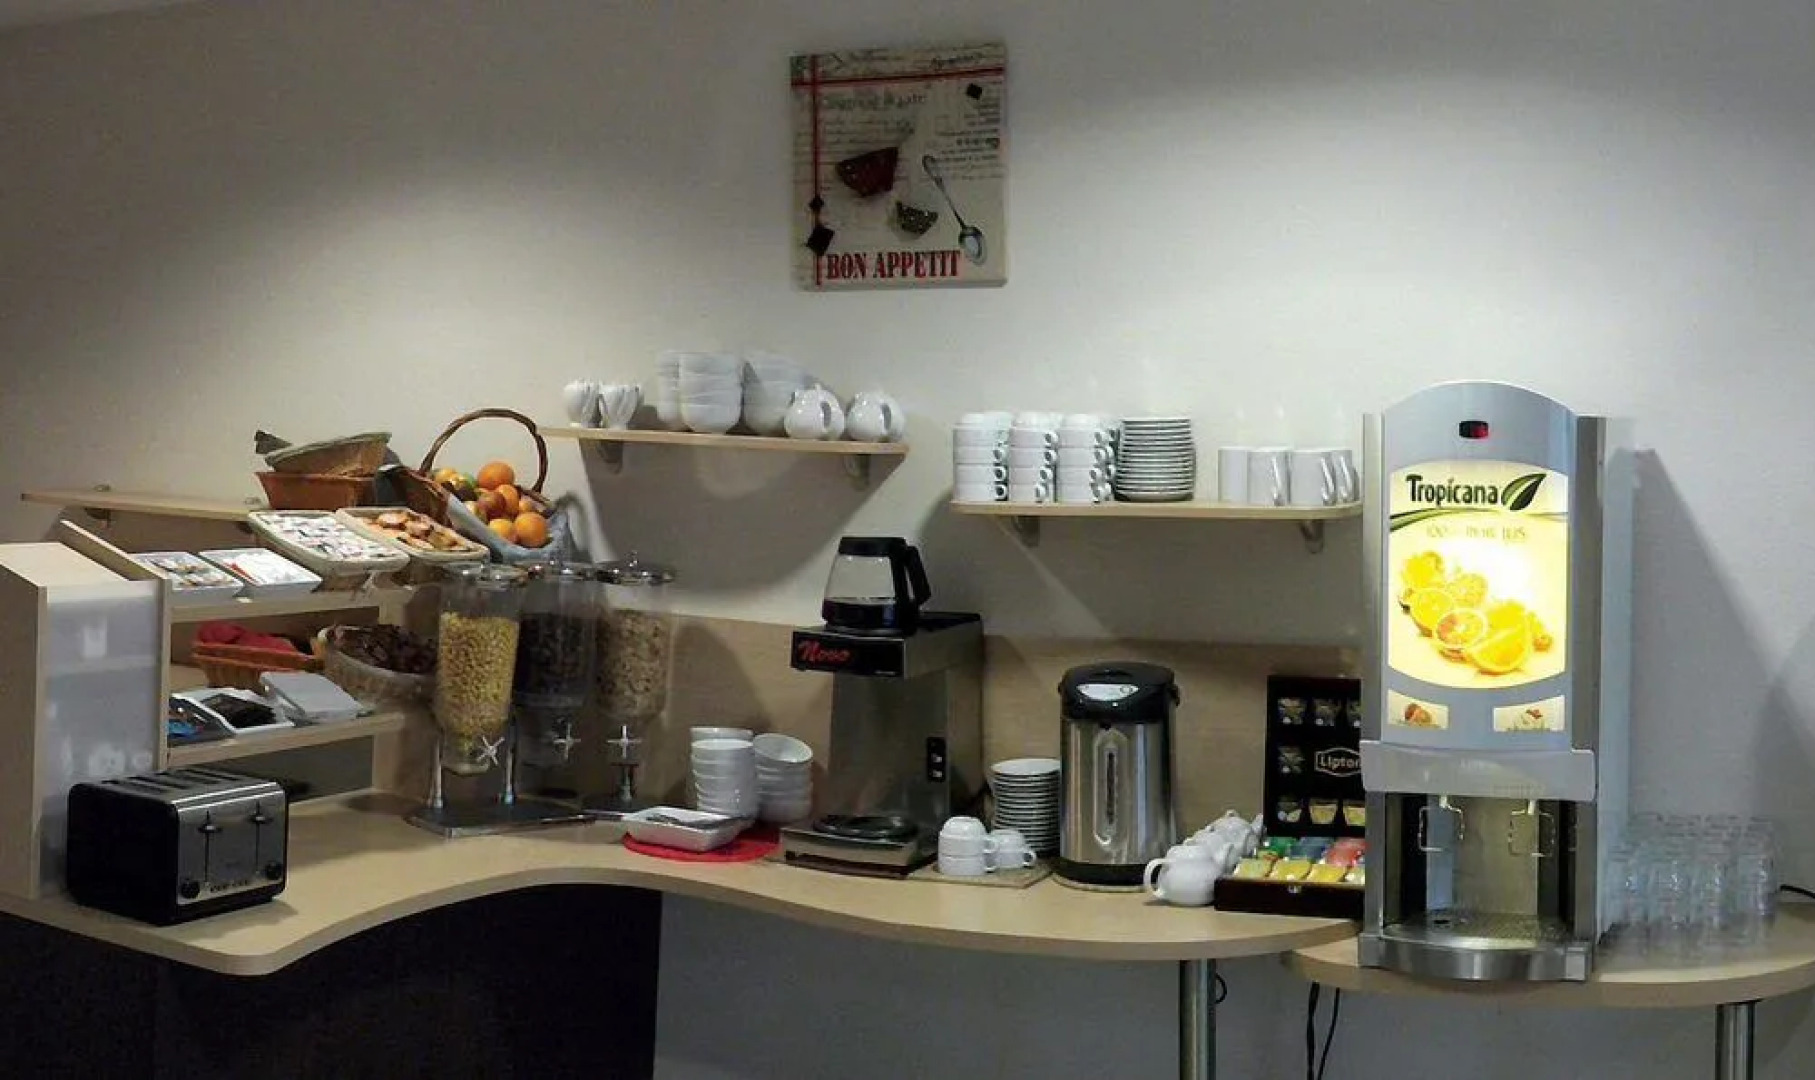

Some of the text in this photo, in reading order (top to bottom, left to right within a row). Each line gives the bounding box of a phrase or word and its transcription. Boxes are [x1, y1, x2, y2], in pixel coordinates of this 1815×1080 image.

[826, 250, 961, 279] BON APPETIT
[1405, 474, 1499, 507] Tropicana
